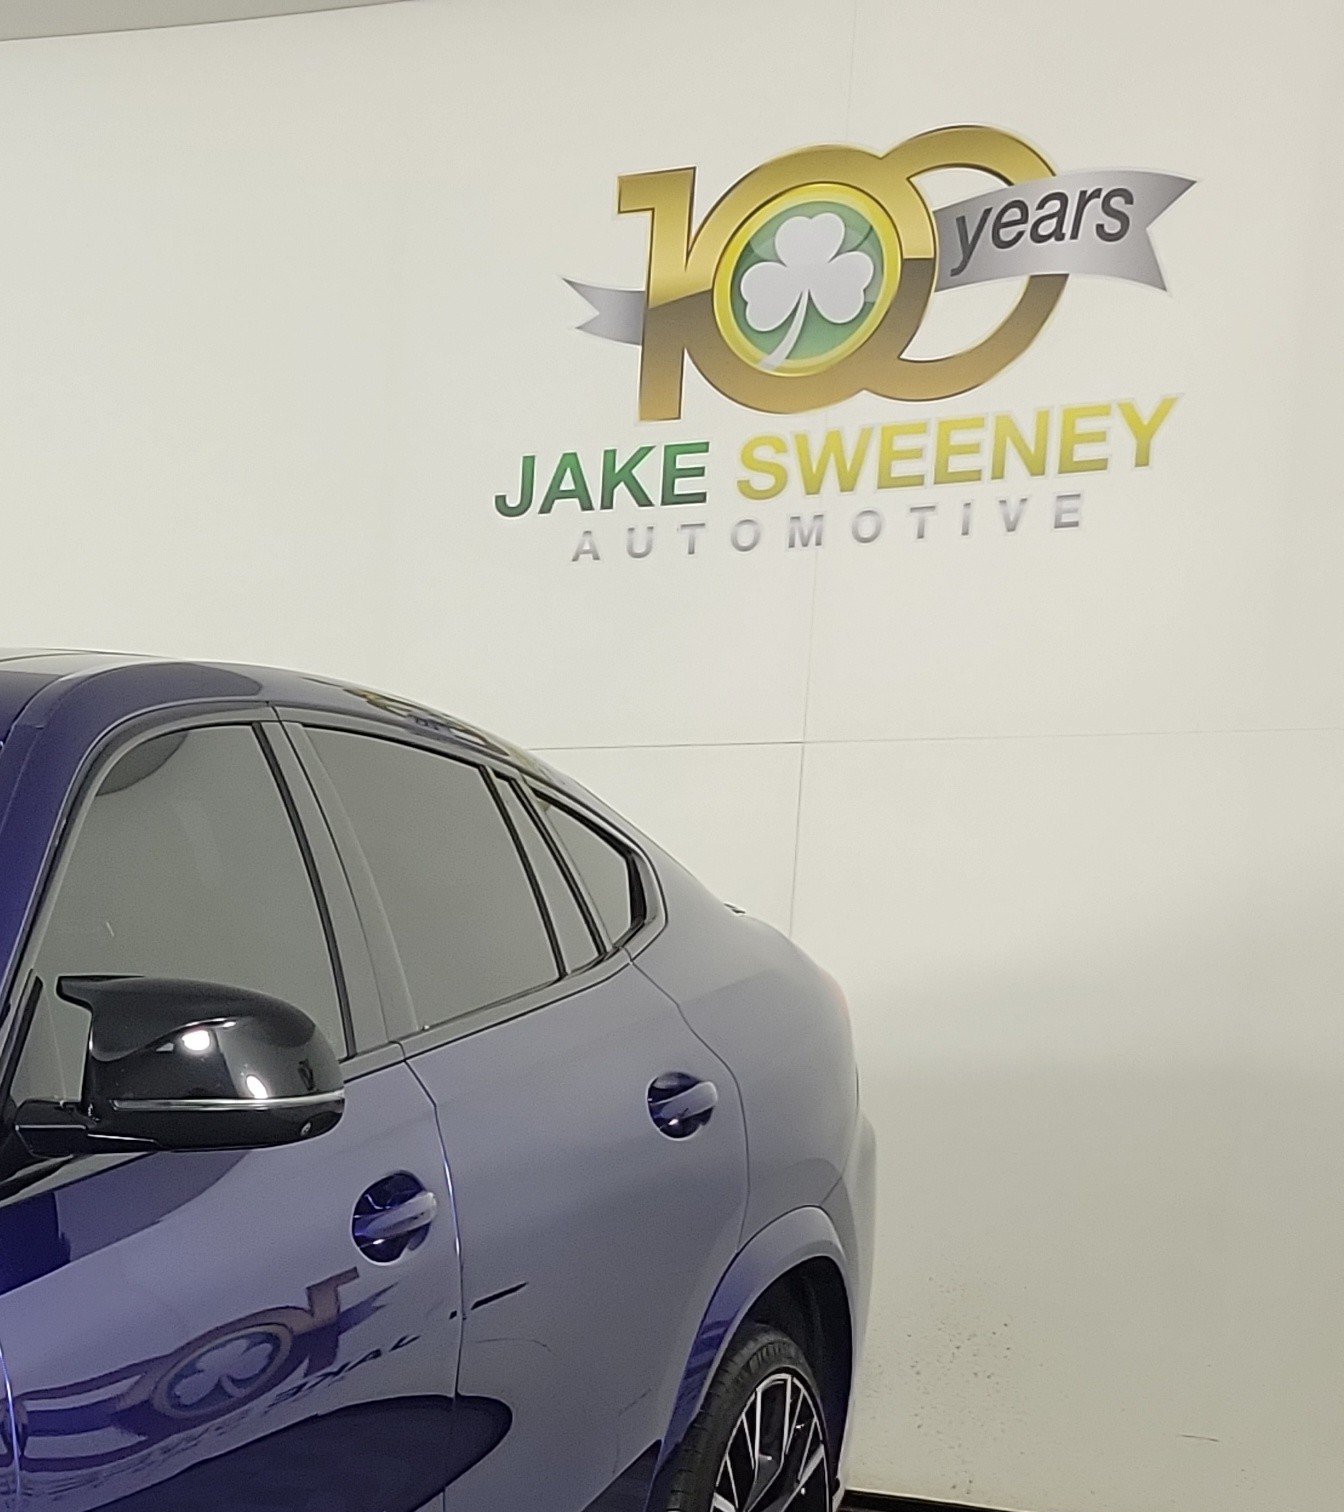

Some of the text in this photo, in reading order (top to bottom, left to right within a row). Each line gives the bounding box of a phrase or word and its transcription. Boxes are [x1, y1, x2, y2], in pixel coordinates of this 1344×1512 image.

[950, 186, 1134, 278] years
[493, 396, 1179, 518] JAKE SWEENEY
[570, 492, 1084, 564] AUTOMOTIVE
